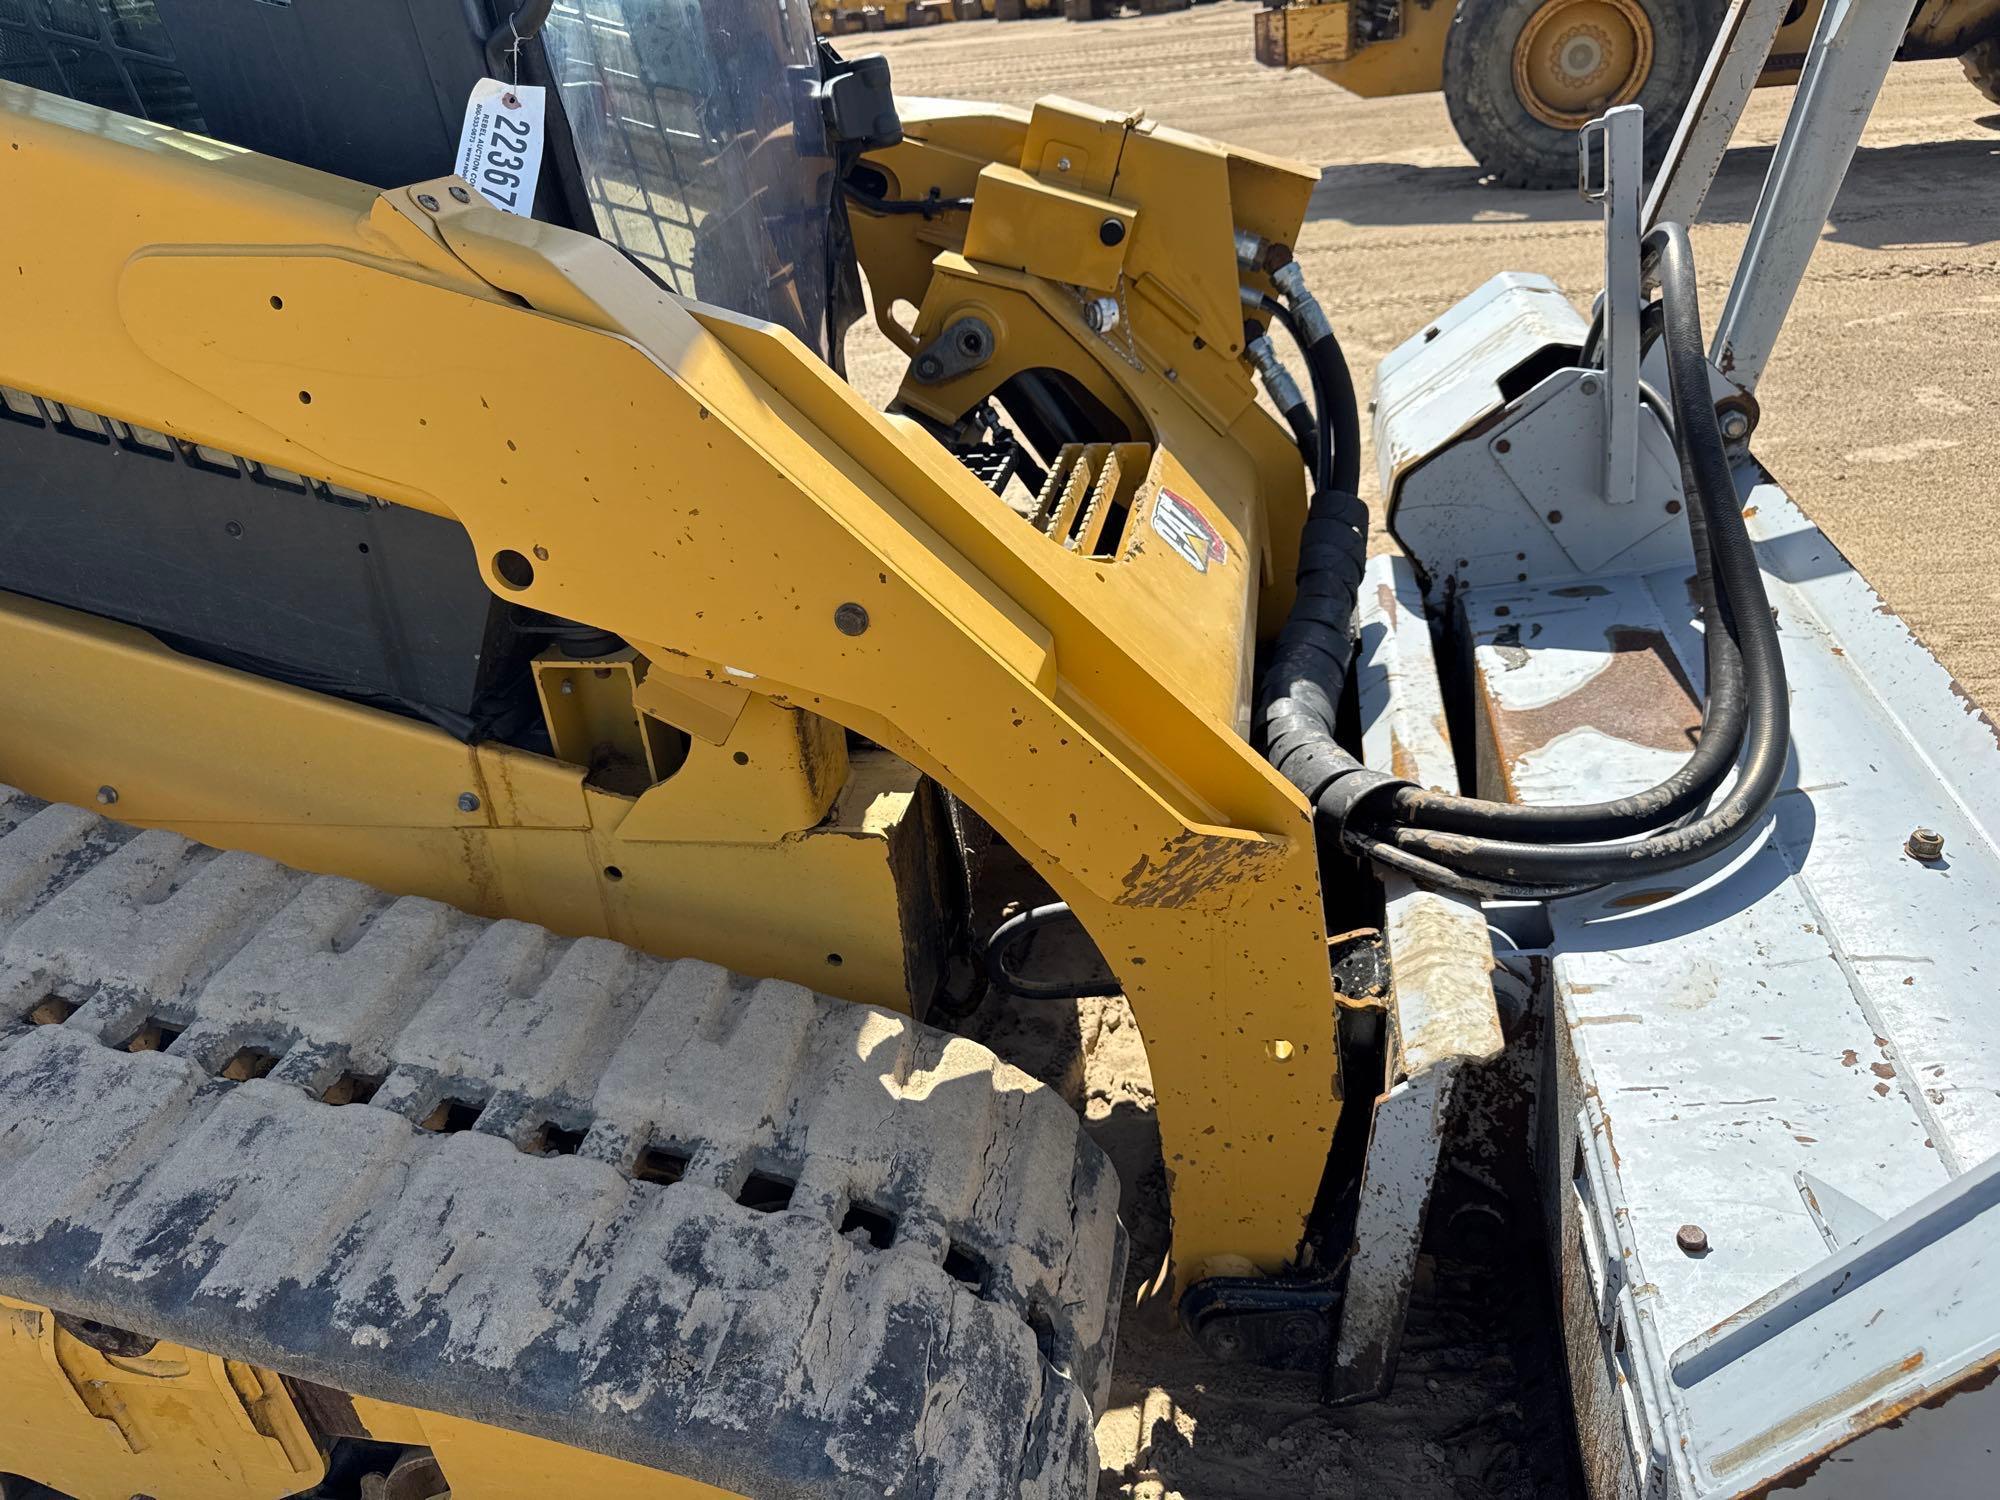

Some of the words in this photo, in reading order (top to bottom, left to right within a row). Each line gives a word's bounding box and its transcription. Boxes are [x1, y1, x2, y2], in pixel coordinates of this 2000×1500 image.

[478, 113, 490, 137] REBEL
[472, 138, 484, 172] AUCTION
[481, 114, 530, 216] 22367
[1152, 489, 1210, 572] CAT
